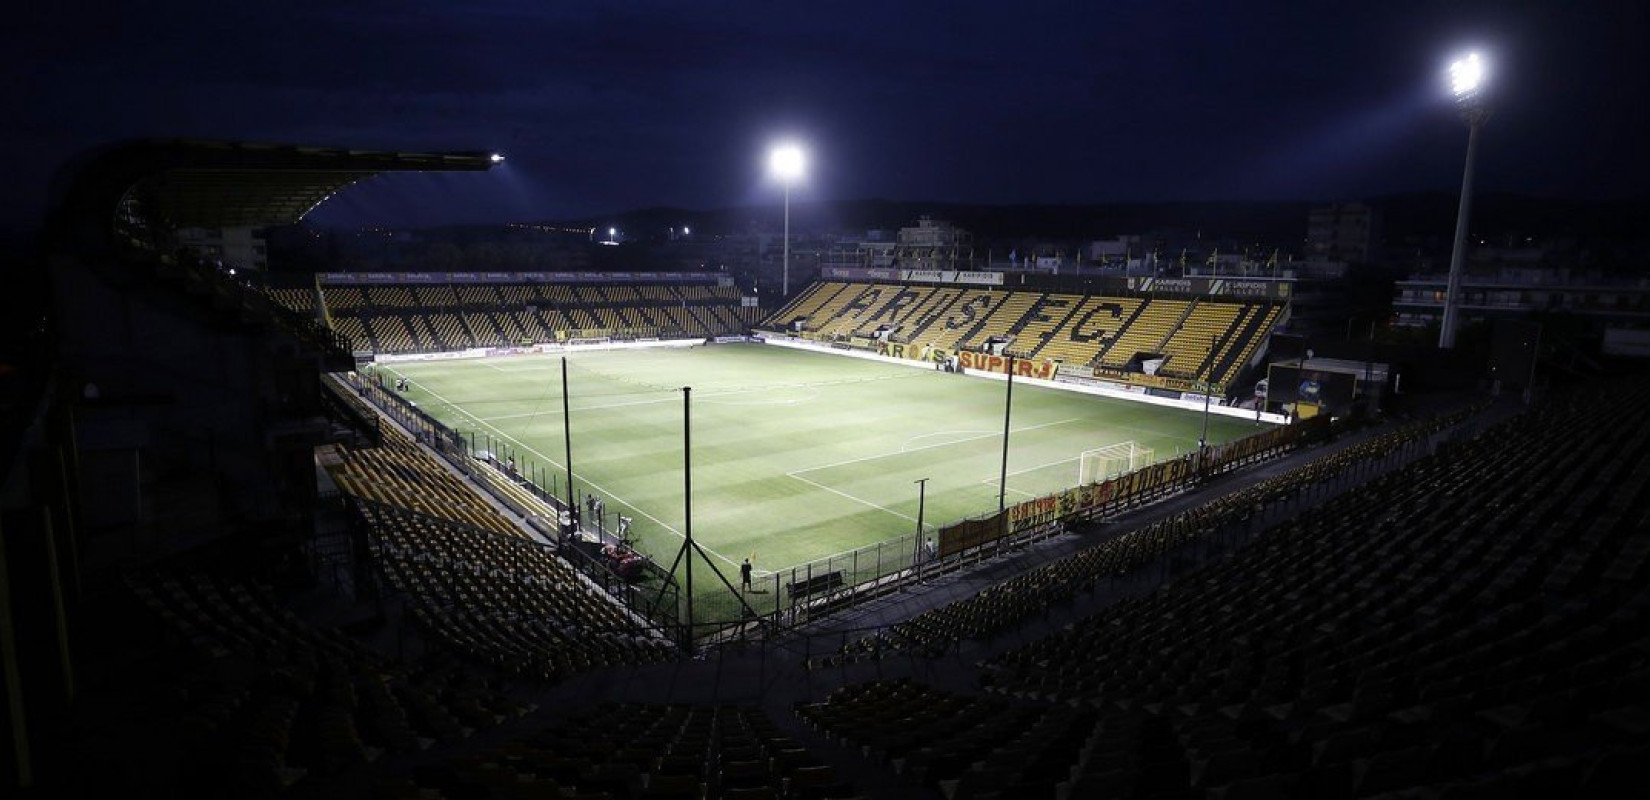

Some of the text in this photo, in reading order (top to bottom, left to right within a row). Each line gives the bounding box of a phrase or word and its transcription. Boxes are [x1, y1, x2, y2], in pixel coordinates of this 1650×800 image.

[836, 289, 1123, 343] ARIS FC
[879, 342, 945, 363] ARS
